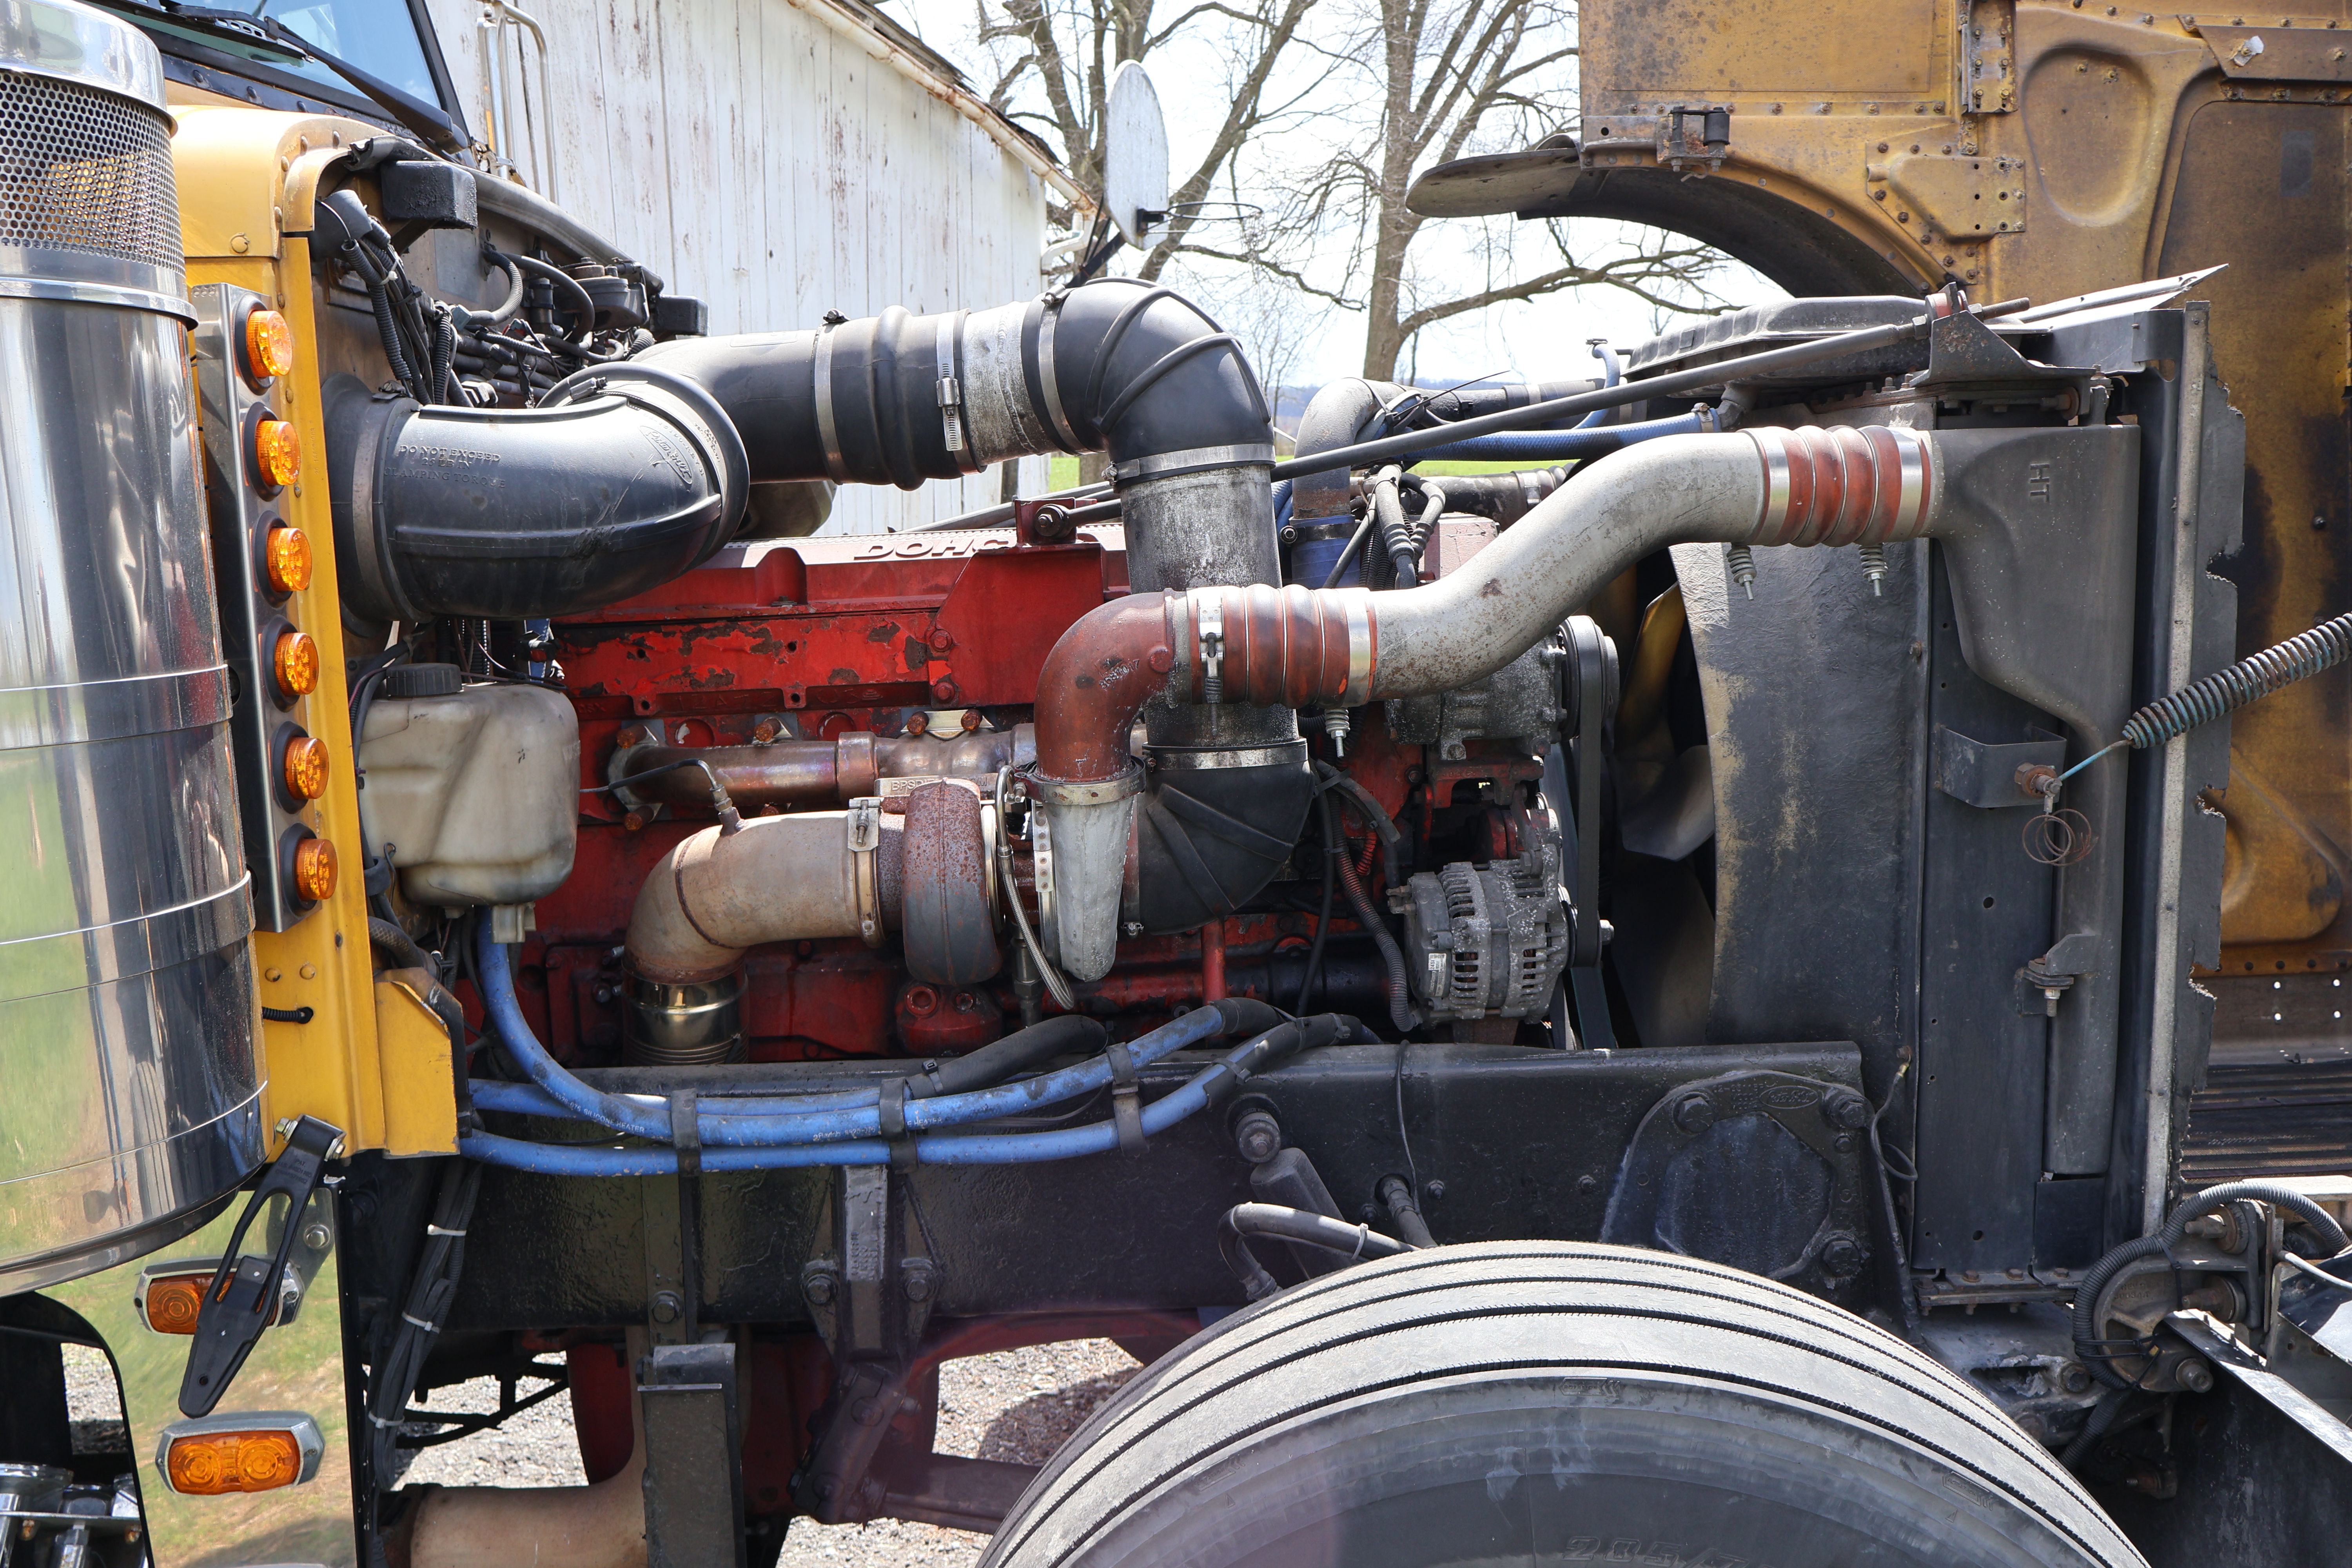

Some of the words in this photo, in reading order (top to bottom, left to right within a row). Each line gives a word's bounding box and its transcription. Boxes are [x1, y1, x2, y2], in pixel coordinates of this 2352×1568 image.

[399, 445, 418, 453] DO
[420, 446, 448, 456] NOT
[450, 448, 501, 461] EXCEED
[421, 457, 435, 466] 25
[457, 460, 473, 470] IN
[384, 467, 450, 481] CLAMPING
[454, 472, 506, 488] TORQUE
[854, 537, 1011, 561] DOHC
[584, 1108, 615, 1127] SILICONE
[616, 1120, 645, 1134] HEATER
